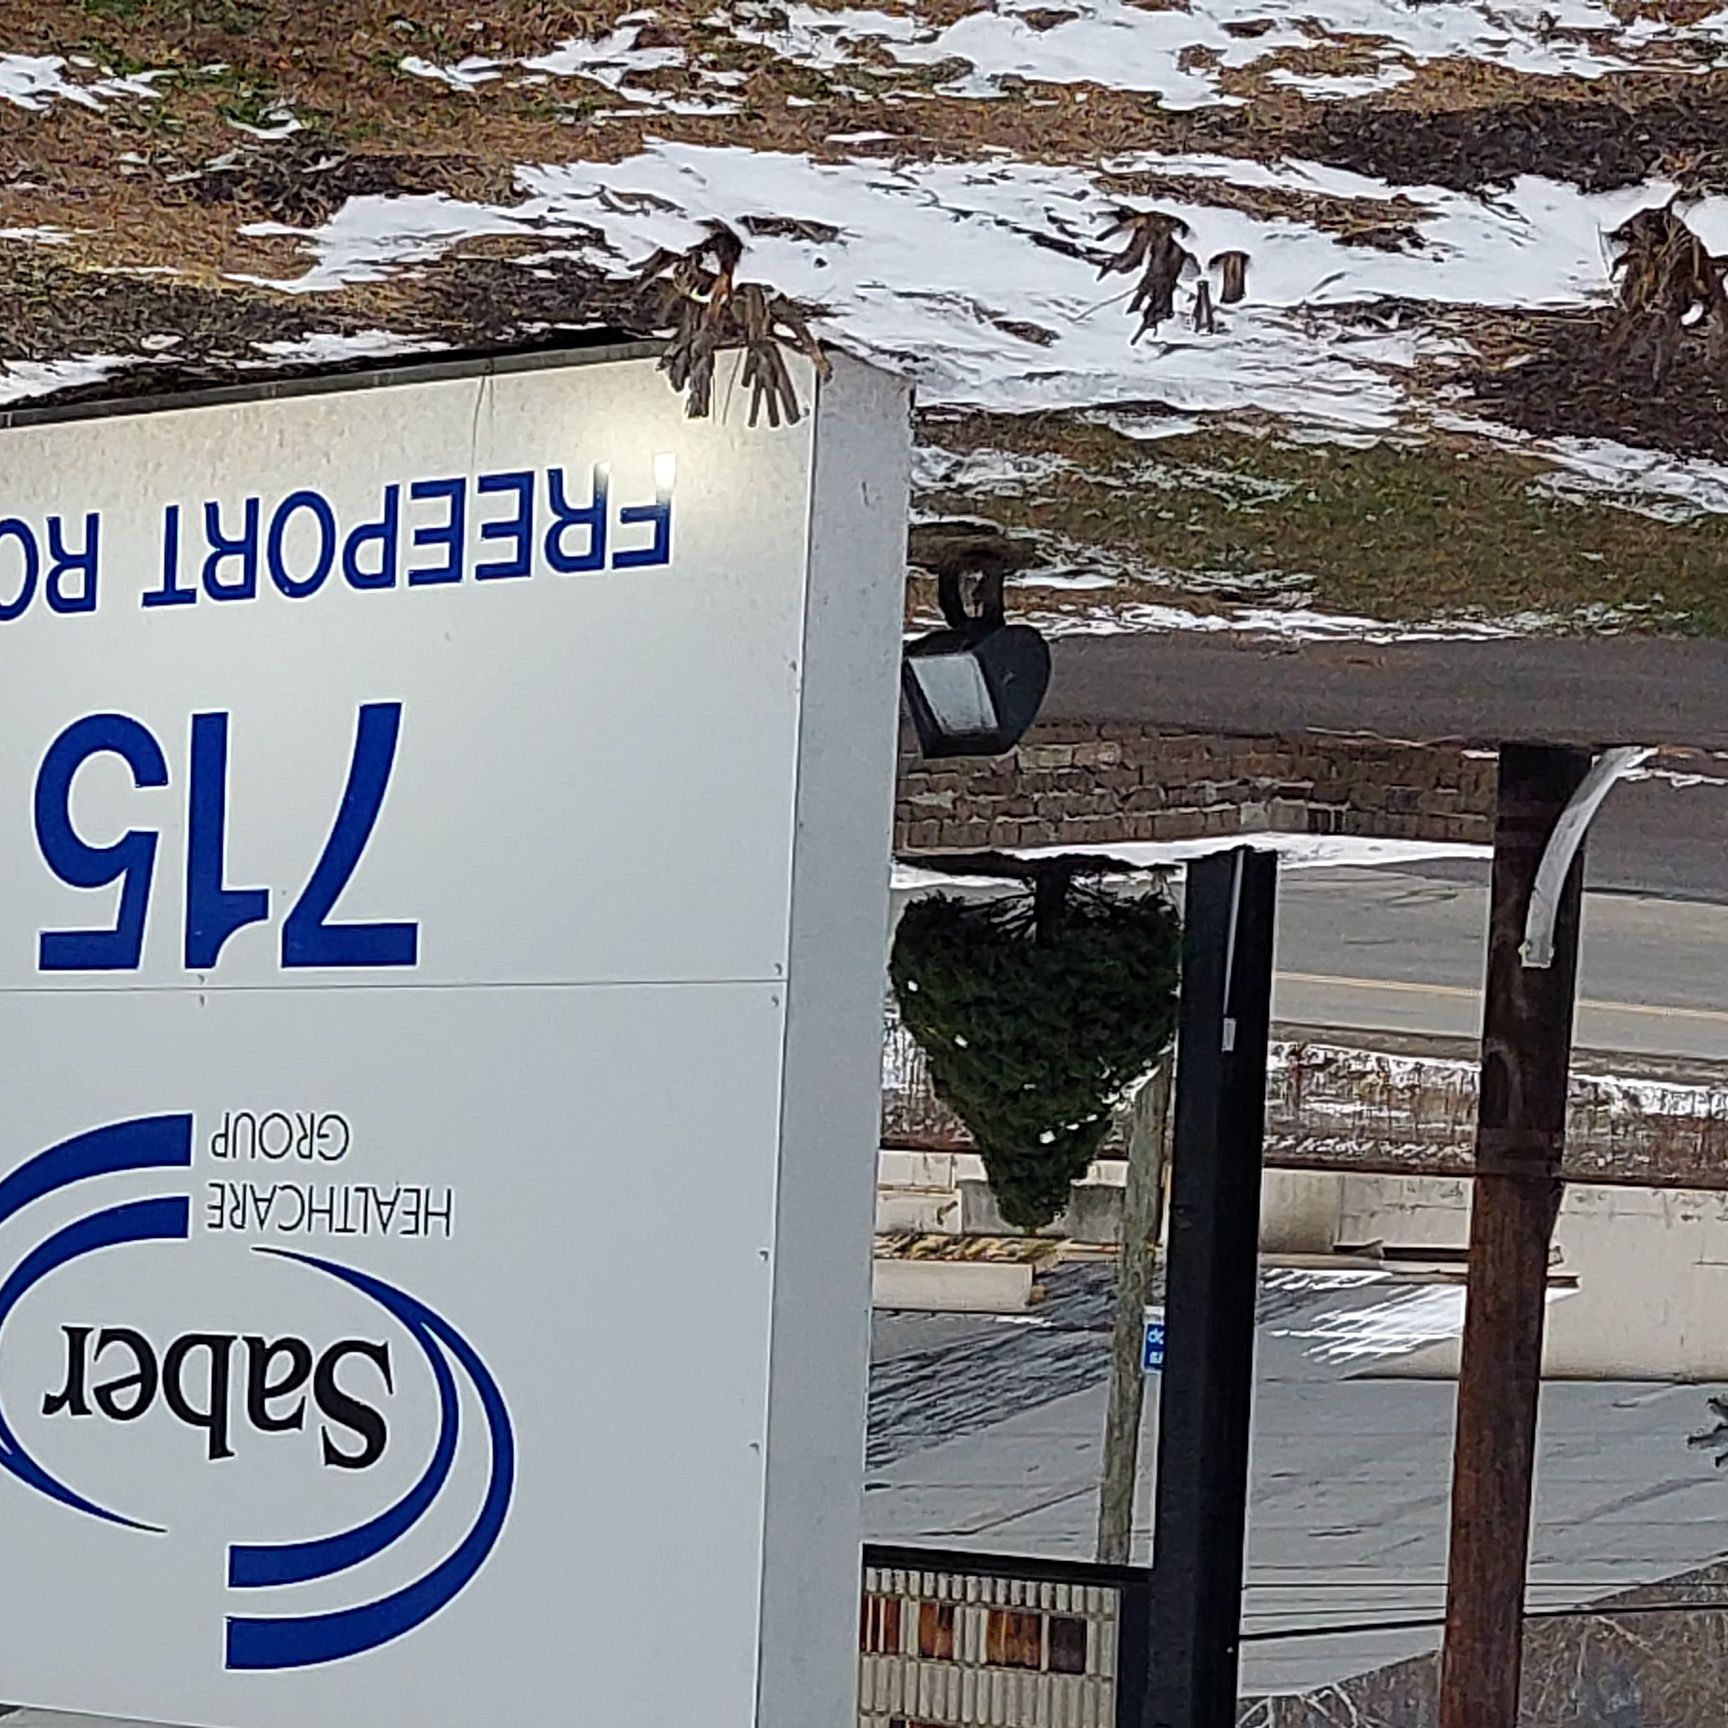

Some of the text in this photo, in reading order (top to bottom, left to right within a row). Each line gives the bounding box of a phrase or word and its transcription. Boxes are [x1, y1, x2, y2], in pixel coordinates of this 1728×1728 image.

[140, 456, 673, 609] FREEPORT
[32, 701, 418, 971] 715
[209, 1110, 351, 1162] GROUP
[205, 1179, 453, 1238] HEALTHCARE
[41, 1325, 394, 1469] Saber
